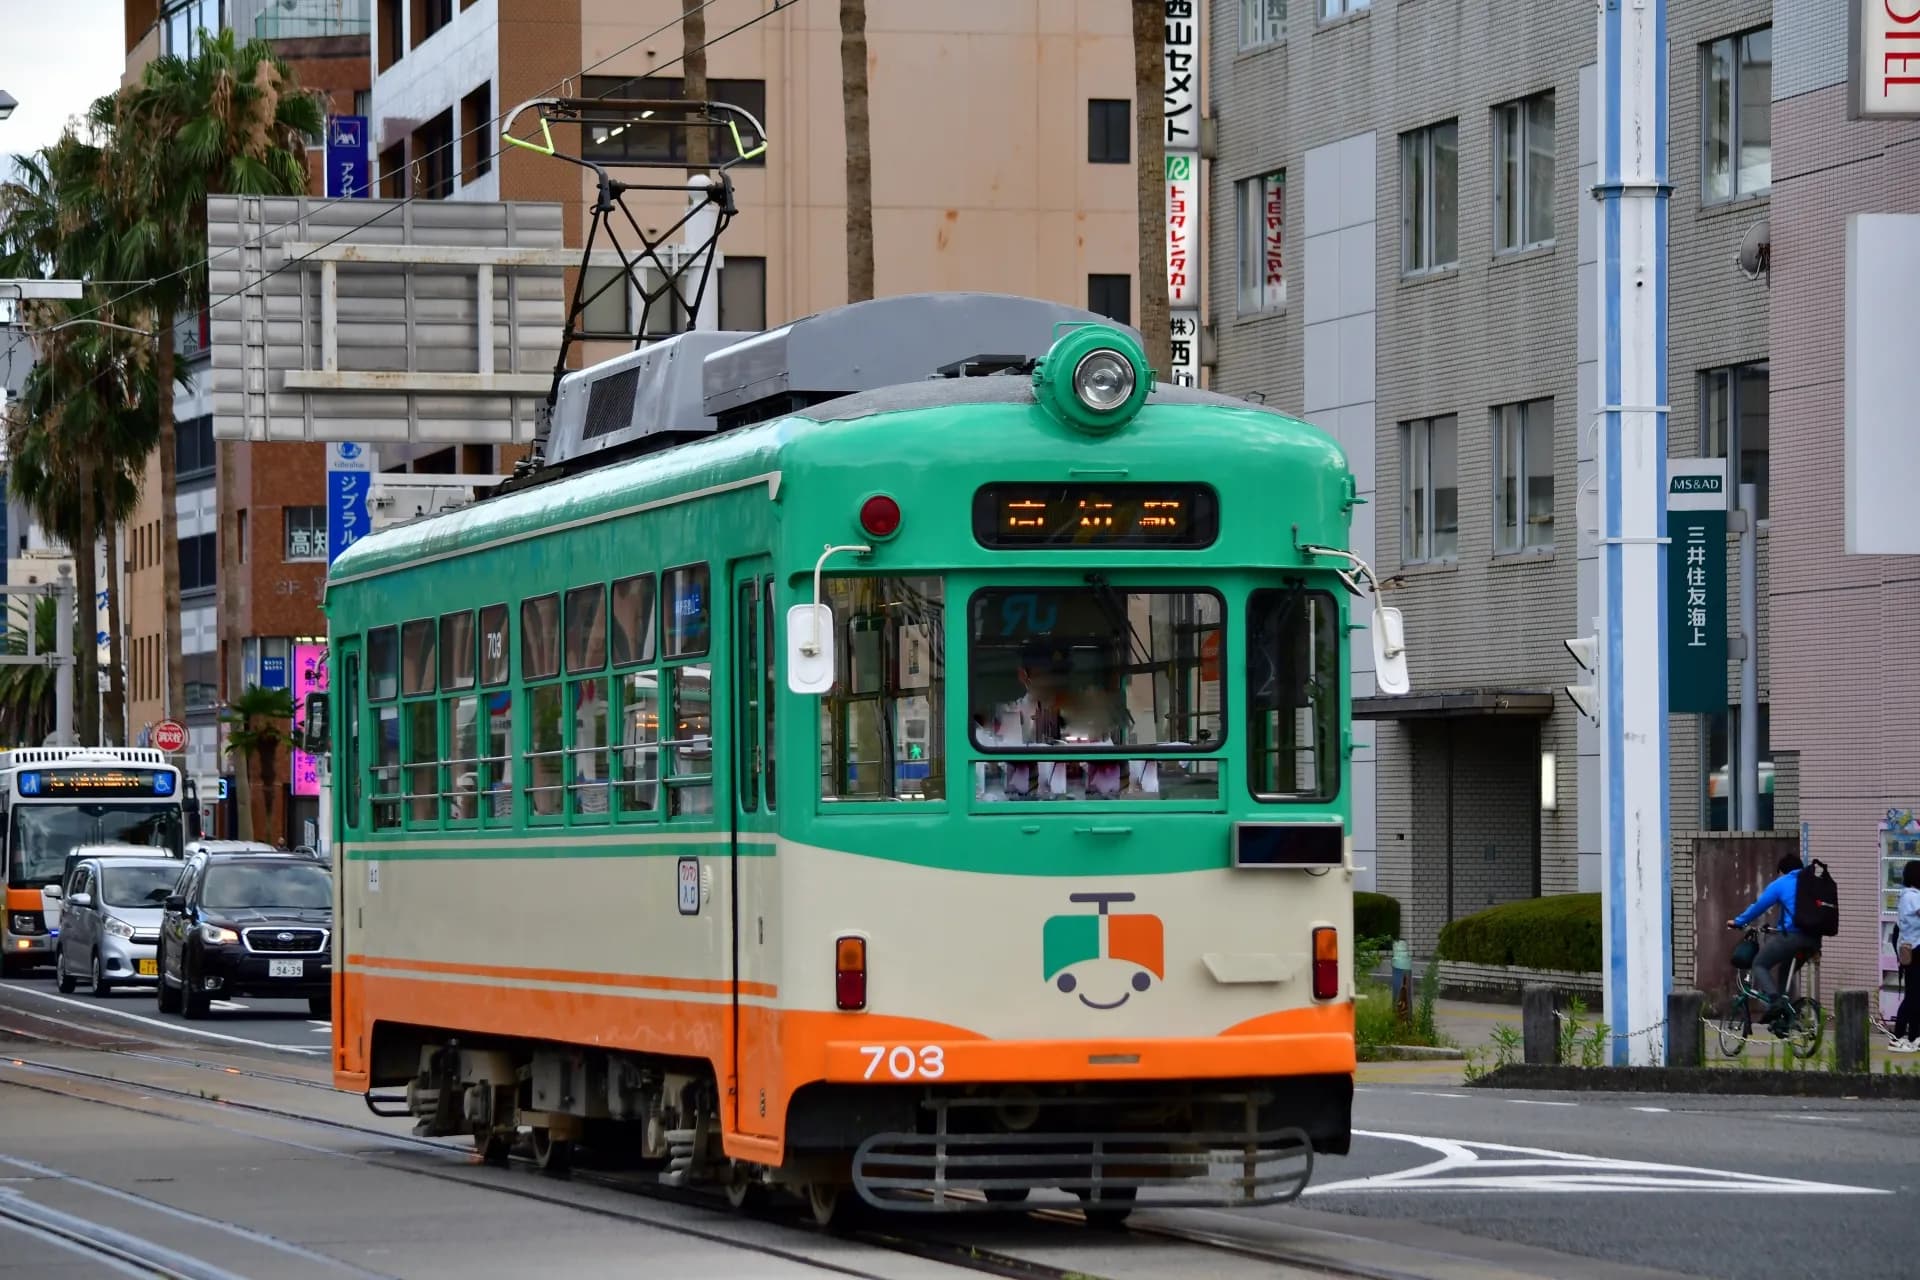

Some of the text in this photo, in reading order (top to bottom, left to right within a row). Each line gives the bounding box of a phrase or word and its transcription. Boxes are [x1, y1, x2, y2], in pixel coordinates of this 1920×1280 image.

[1164, 0, 1192, 142] 西山セメント
[1170, 186, 1186, 300] トヨタレンタカー
[1674, 479, 1719, 490] MS&AD
[1687, 526, 1707, 647] 三井住友海上
[487, 632, 502, 658] 703
[860, 1045, 945, 1080] 703
